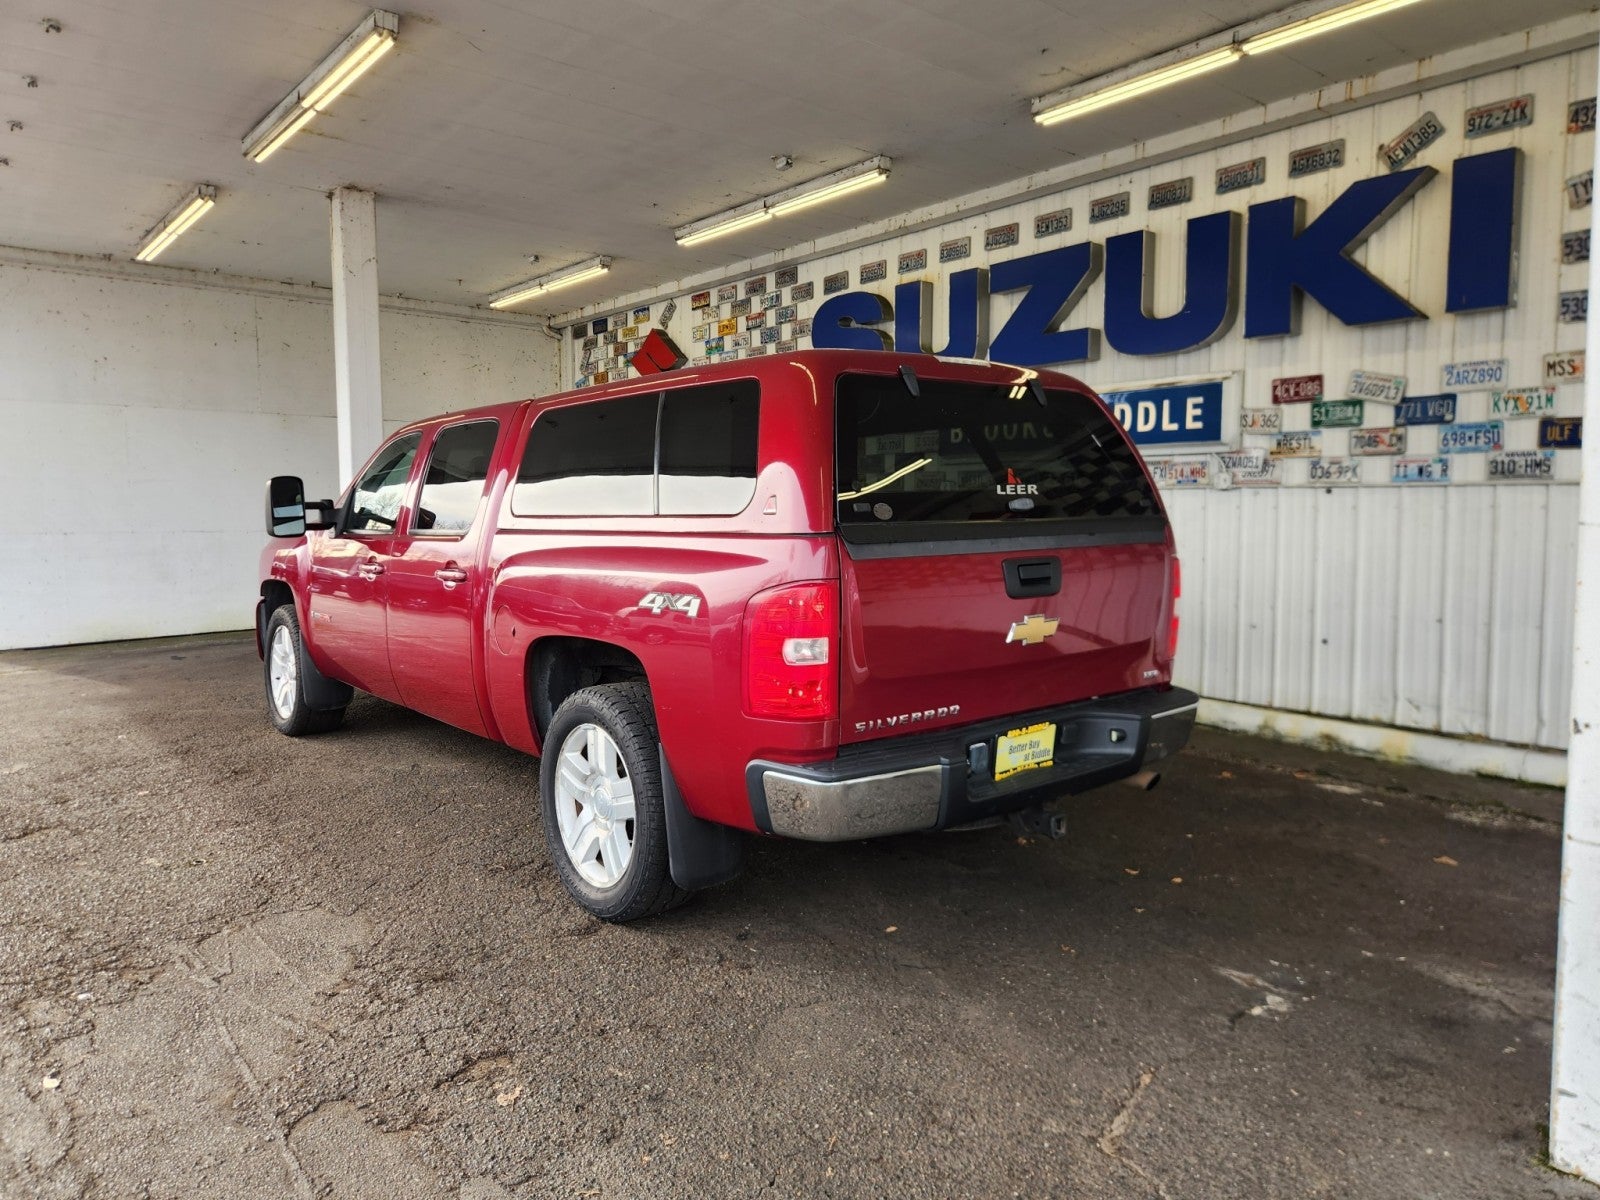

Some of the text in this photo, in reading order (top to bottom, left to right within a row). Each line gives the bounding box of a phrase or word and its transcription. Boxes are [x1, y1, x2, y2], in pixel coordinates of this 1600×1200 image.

[811, 147, 1524, 367] SUZUKI
[996, 484, 1039, 495] LEER
[854, 704, 961, 733] SILVERADO
